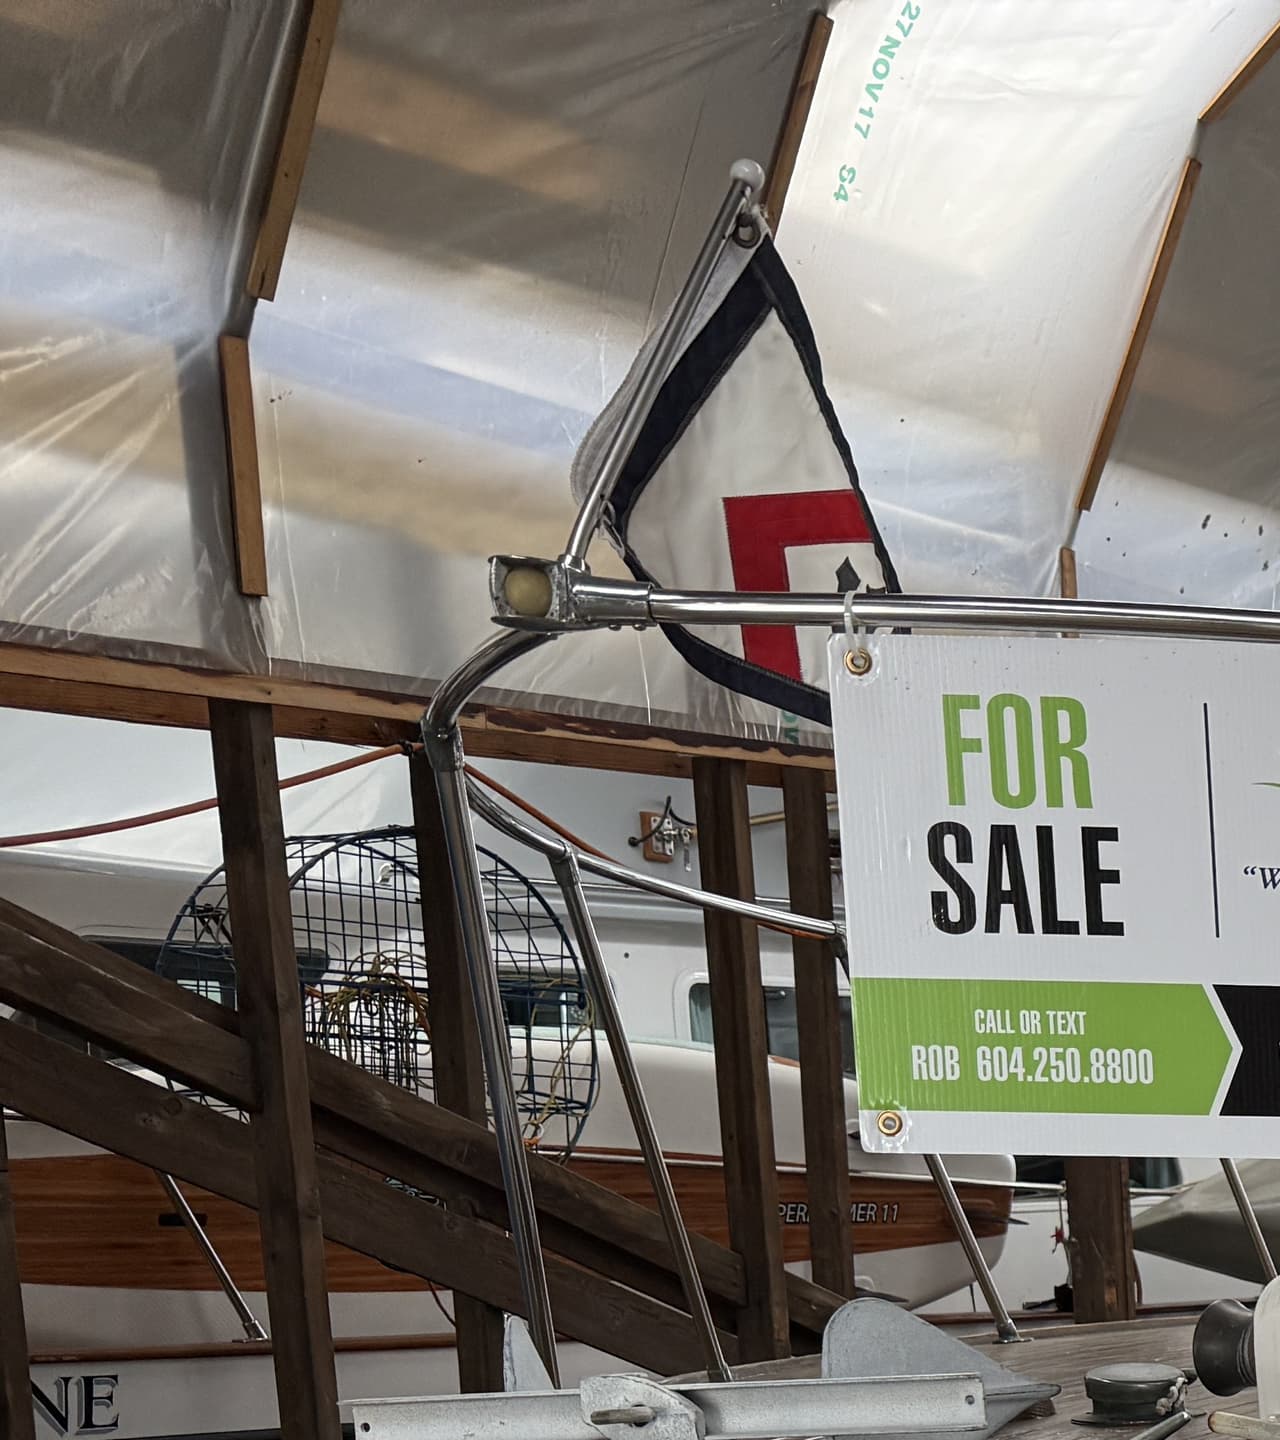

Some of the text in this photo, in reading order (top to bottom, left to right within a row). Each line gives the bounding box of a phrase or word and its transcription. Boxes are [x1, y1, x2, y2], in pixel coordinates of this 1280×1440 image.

[942, 693, 1093, 810] FOR
[926, 820, 1126, 938] SALE
[974, 1008, 1088, 1036] CALL OR TEXT
[911, 1044, 1155, 1085] ROB 604.250.8800
[882, 1203, 900, 1224] 11
